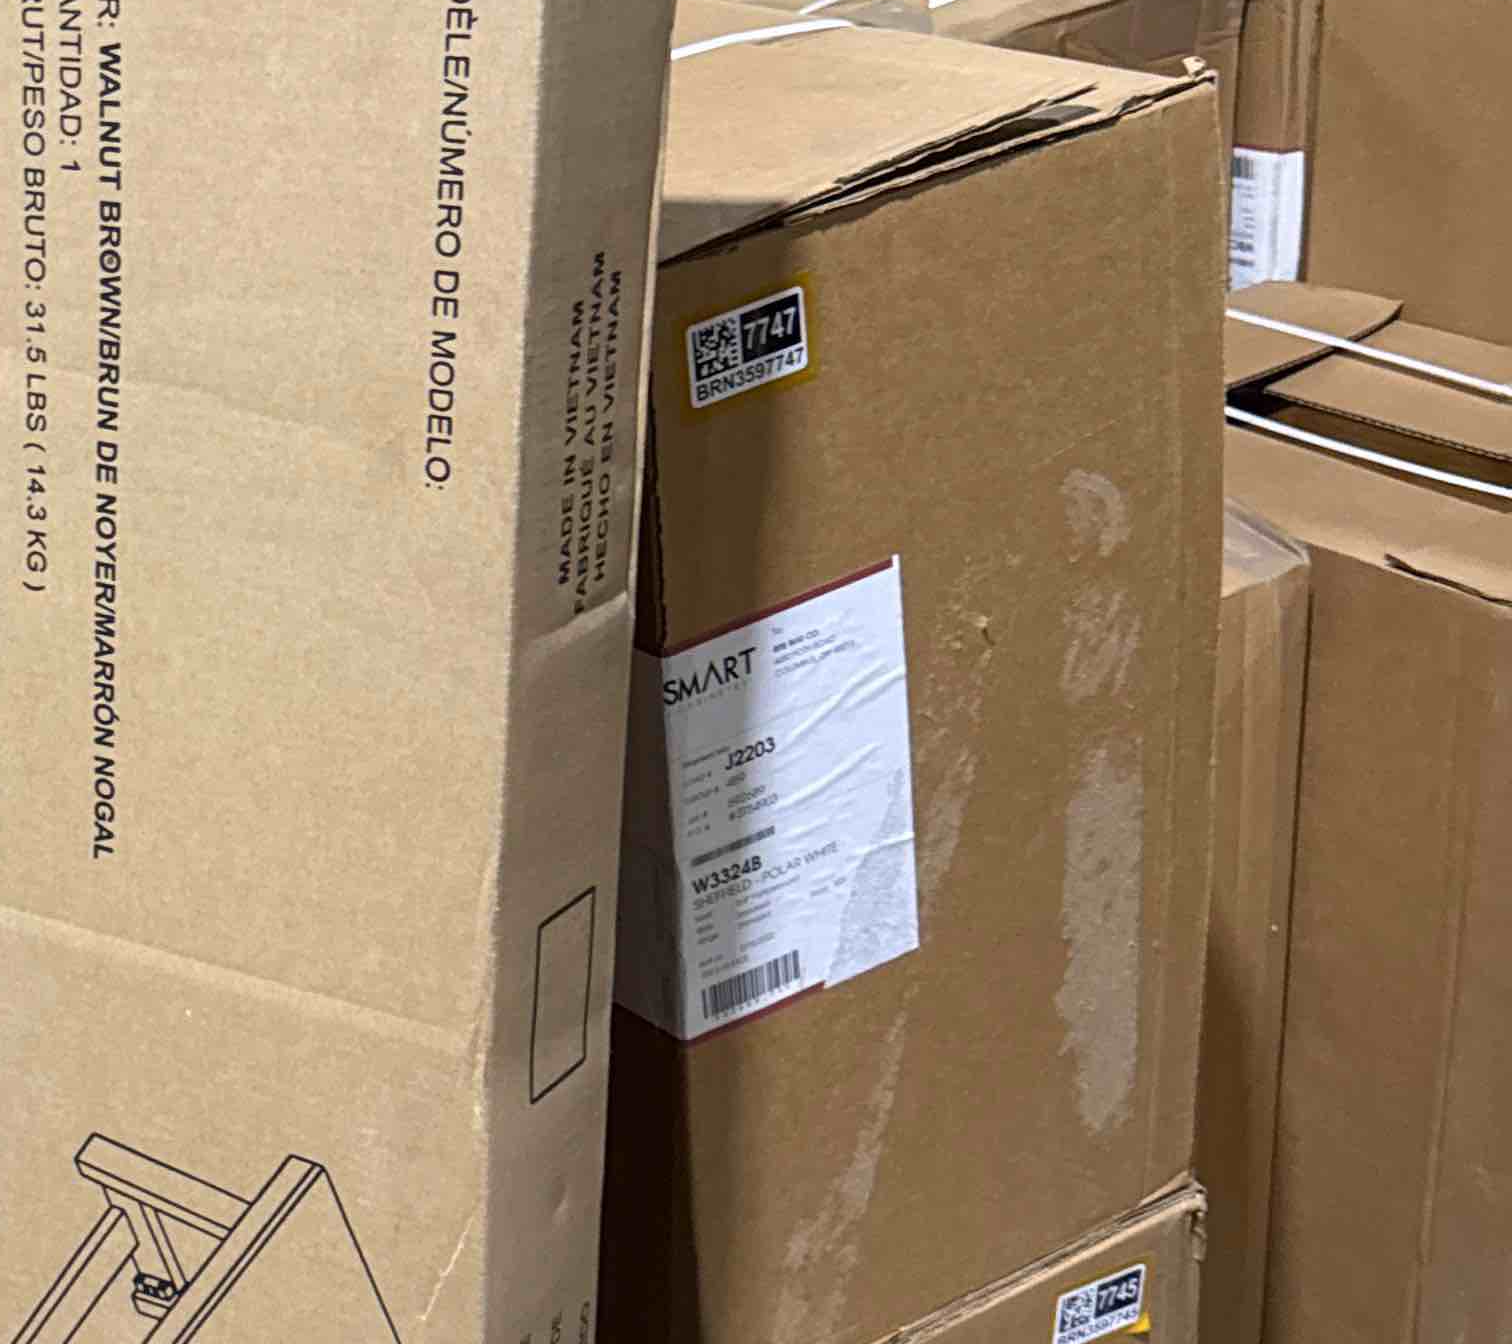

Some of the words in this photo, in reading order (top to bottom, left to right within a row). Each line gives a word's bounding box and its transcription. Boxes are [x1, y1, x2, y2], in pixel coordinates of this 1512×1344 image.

[97, 42, 123, 190] WALNUT
[59, 161, 80, 173] 1
[23, 169, 48, 290] BRUTO:
[96, 201, 123, 433] BROWN/BRUN
[430, 269, 461, 321] DE
[585, 251, 605, 397] VIETNAM
[24, 299, 48, 363] 31.5
[602, 269, 622, 412] VIETNAM
[743, 306, 797, 350] 7747
[23, 370, 48, 433] LBS
[564, 300, 585, 446] VIETNAM
[696, 346, 805, 402] BRN3597747
[424, 329, 457, 491] MODELO:
[584, 404, 597, 446] AU
[95, 440, 119, 485] DE
[563, 454, 577, 485] IN
[600, 421, 614, 463] EN
[26, 463, 48, 523] 14.3
[24, 529, 48, 575] KG
[557, 495, 575, 585] MADE
[594, 472, 611, 582] HECHO
[92, 493, 119, 747] NOYER/MARRÓN
[663, 647, 756, 705] SMART
[724, 736, 776, 771] J2203
[92, 754, 117, 862] NOGAL
[691, 855, 763, 895] W3324B
[1098, 1278, 1138, 1310] 7745
